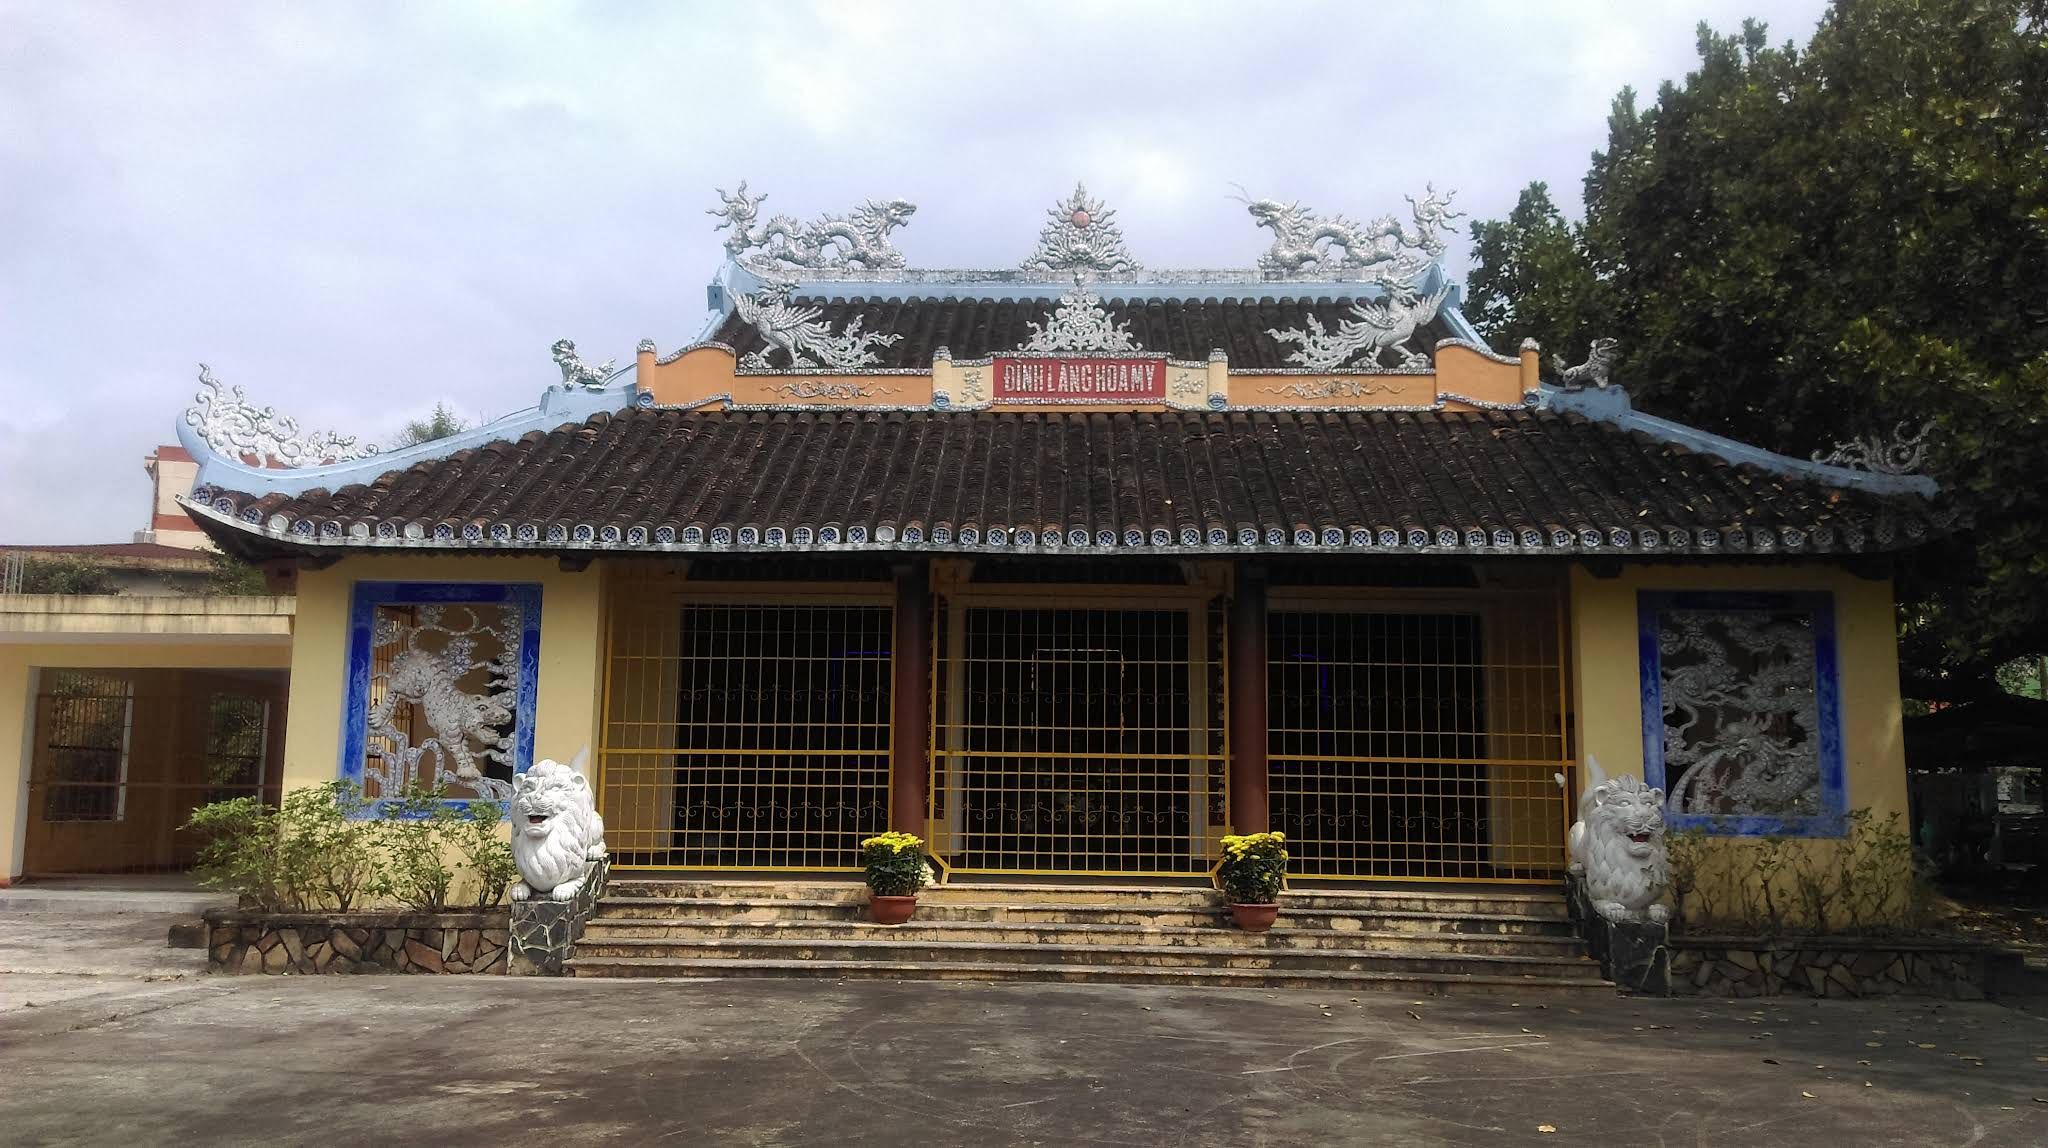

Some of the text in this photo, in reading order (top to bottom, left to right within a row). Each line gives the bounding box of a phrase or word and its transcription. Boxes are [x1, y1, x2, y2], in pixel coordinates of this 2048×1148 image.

[1004, 359, 1044, 392] ĐÌNH
[1047, 359, 1092, 392] LÀNG
[1095, 361, 1129, 392] HÒA
